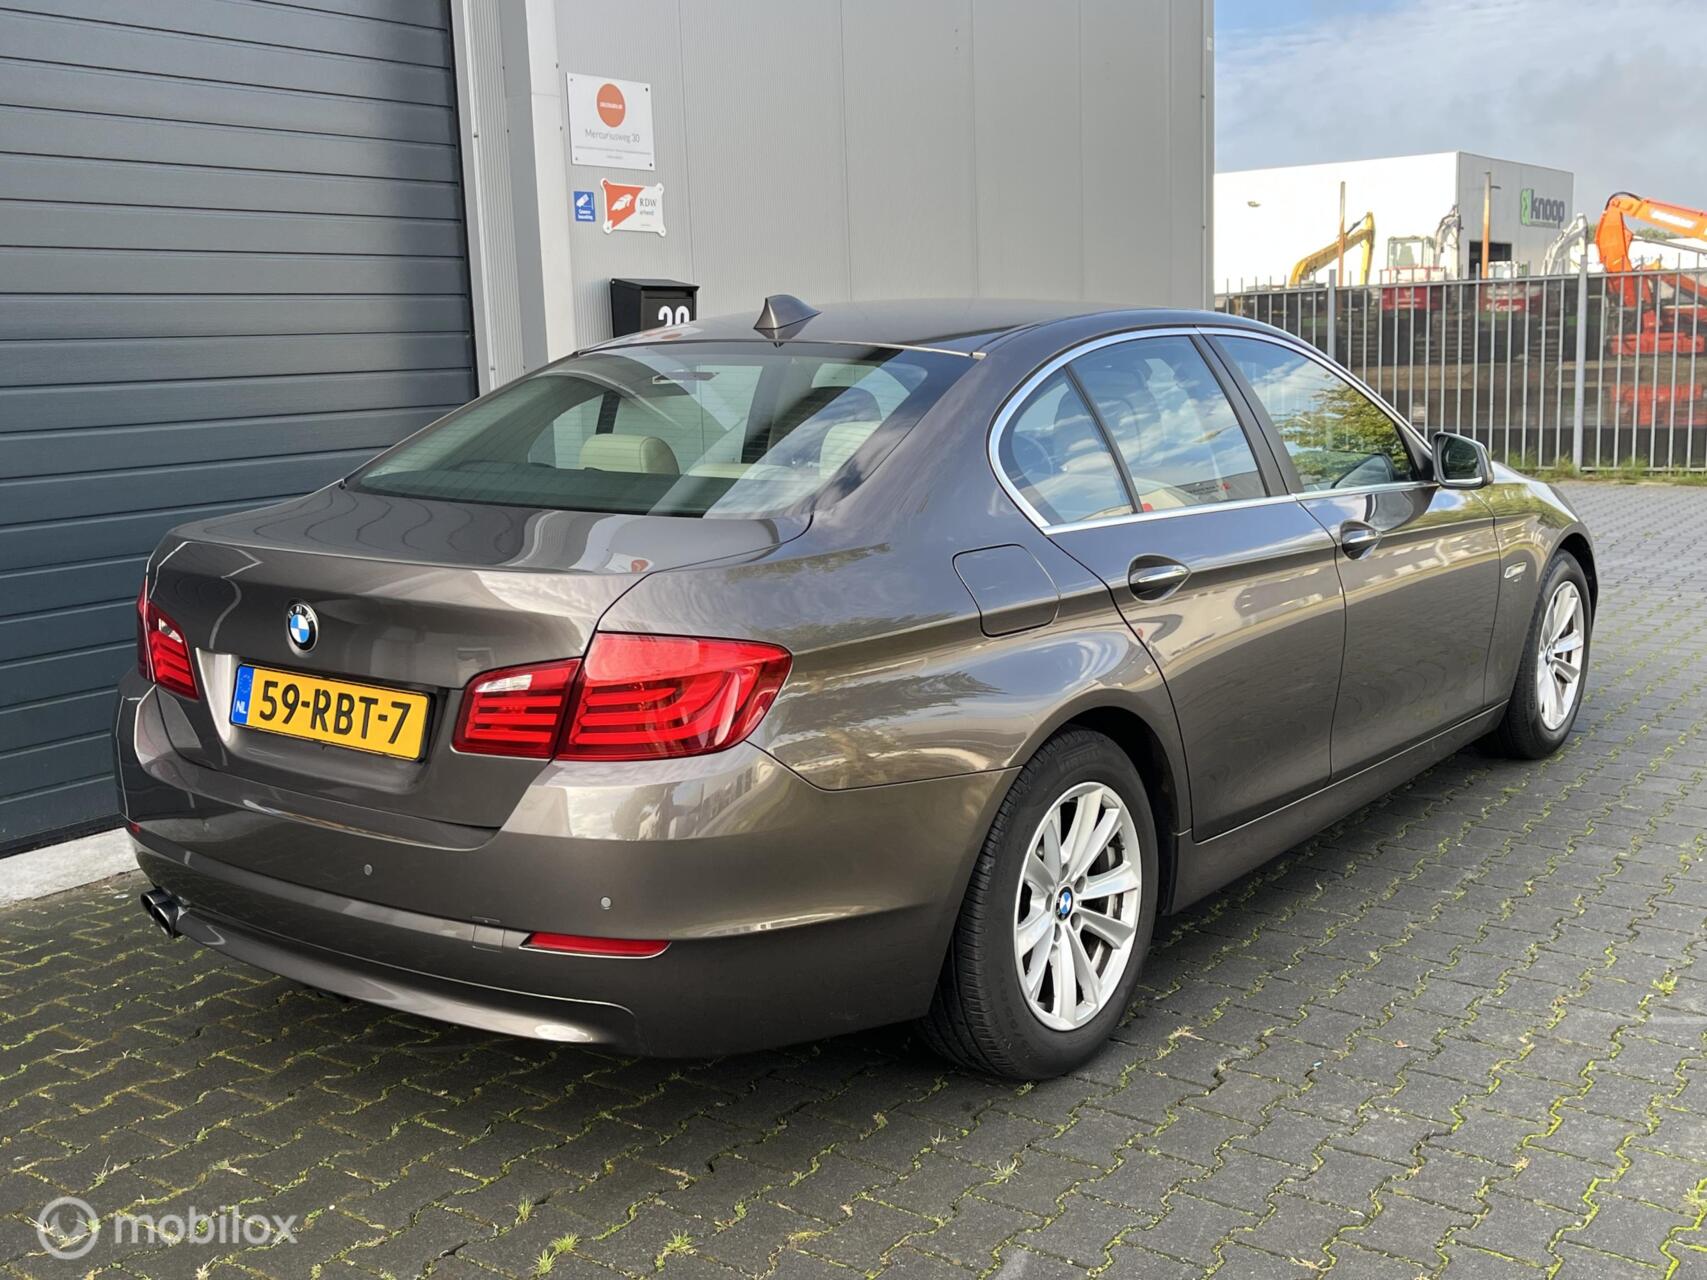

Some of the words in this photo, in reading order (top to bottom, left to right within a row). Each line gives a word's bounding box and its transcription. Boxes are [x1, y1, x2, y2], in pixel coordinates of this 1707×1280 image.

[631, 132, 641, 144] 30
[640, 198, 657, 207] RDW
[1530, 188, 1565, 229] knoop
[235, 700, 247, 714] NL
[259, 680, 412, 745] 59-RBT-7
